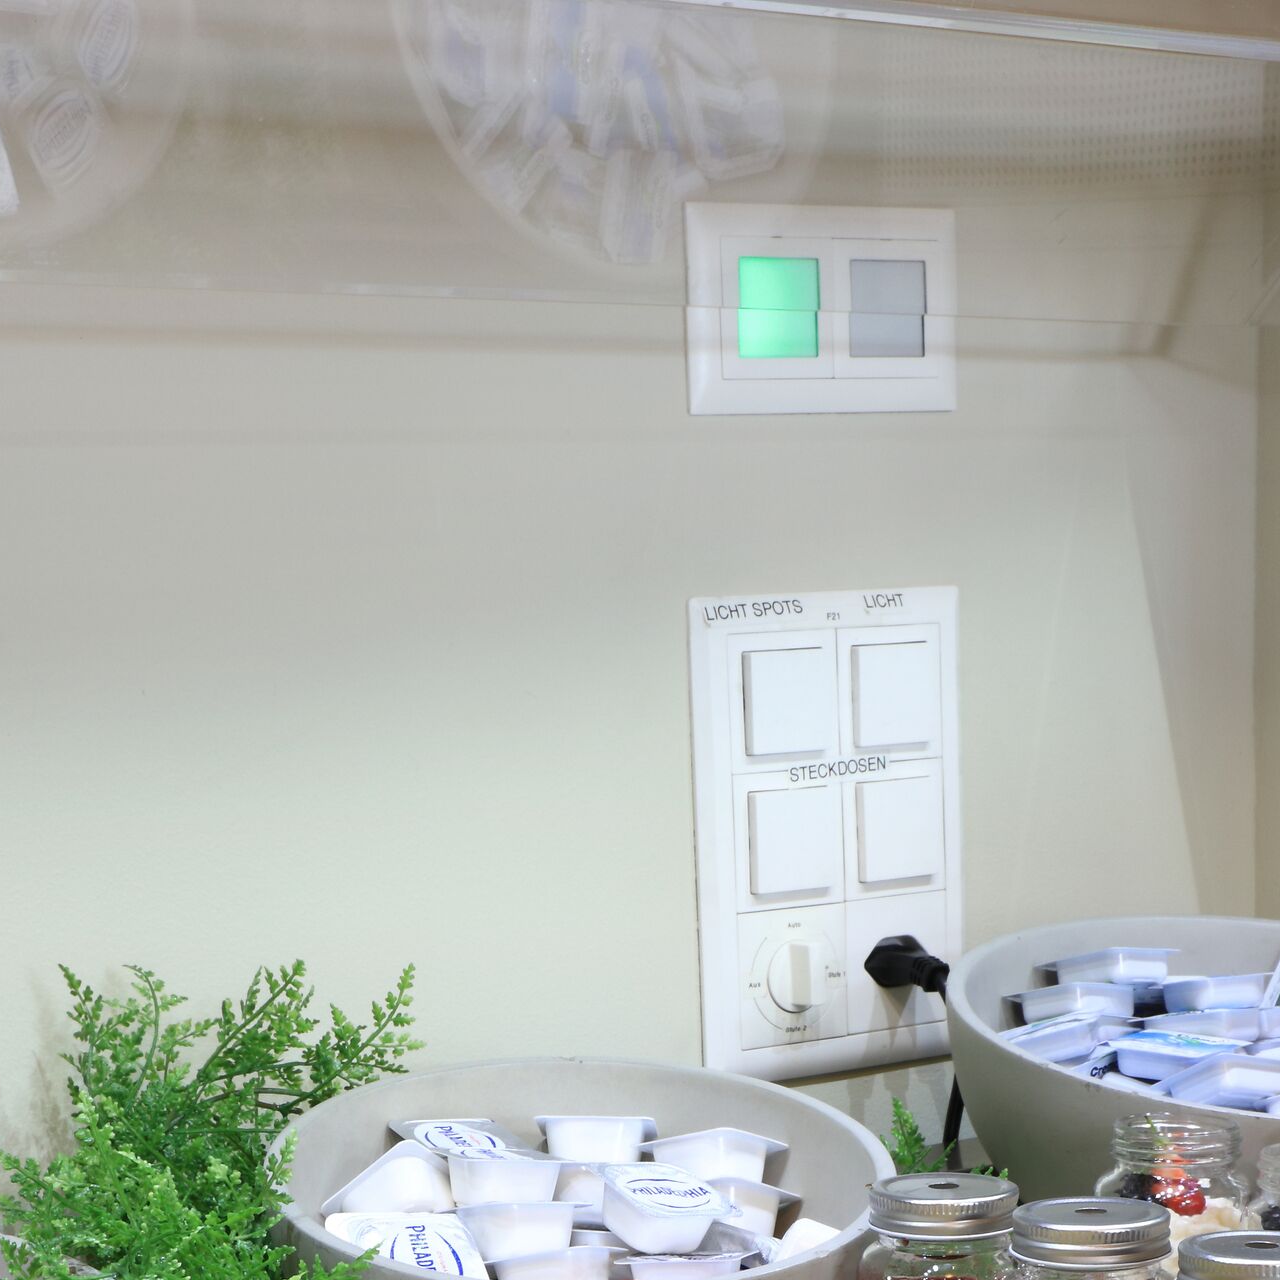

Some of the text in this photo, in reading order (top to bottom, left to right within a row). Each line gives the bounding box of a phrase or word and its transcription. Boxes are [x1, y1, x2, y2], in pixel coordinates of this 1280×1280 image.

[704, 599, 804, 622] LICHT SPOTS
[863, 592, 904, 609] LICHT
[826, 612, 841, 621] F21
[789, 756, 887, 783] STECKDOSEN
[405, 1224, 437, 1272] PHILAD
